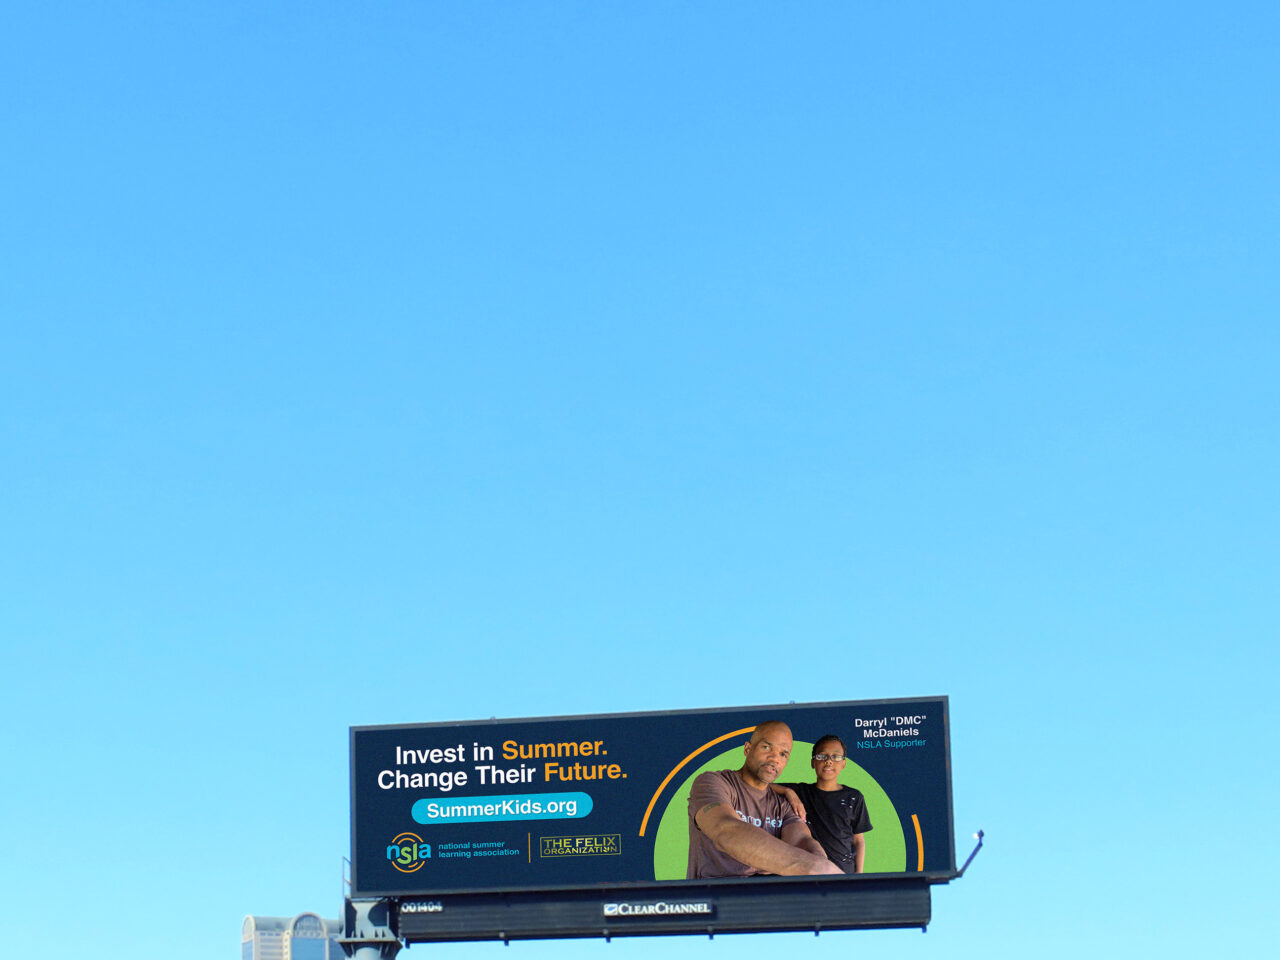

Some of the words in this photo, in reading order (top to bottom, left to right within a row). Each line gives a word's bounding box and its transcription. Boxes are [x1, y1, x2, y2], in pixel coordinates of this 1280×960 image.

[854, 717, 887, 728] Darryl
[890, 715, 927, 725] "DMC"
[863, 728, 920, 738] McDaniels
[857, 740, 882, 749] NSLA
[884, 739, 927, 749] Supporter
[396, 743, 465, 765] Invest
[473, 742, 494, 761] in
[502, 740, 608, 760] Summer.
[377, 769, 468, 792] Change
[475, 764, 537, 785] Their
[544, 762, 628, 782] Future.
[426, 799, 578, 819] SummerKids.org
[438, 842, 471, 850] national
[472, 841, 505, 849] summer
[543, 838, 572, 848] THE
[575, 837, 616, 847] FELIX
[386, 842, 432, 864] nsla
[438, 850, 472, 859] learning
[473, 848, 520, 857] association
